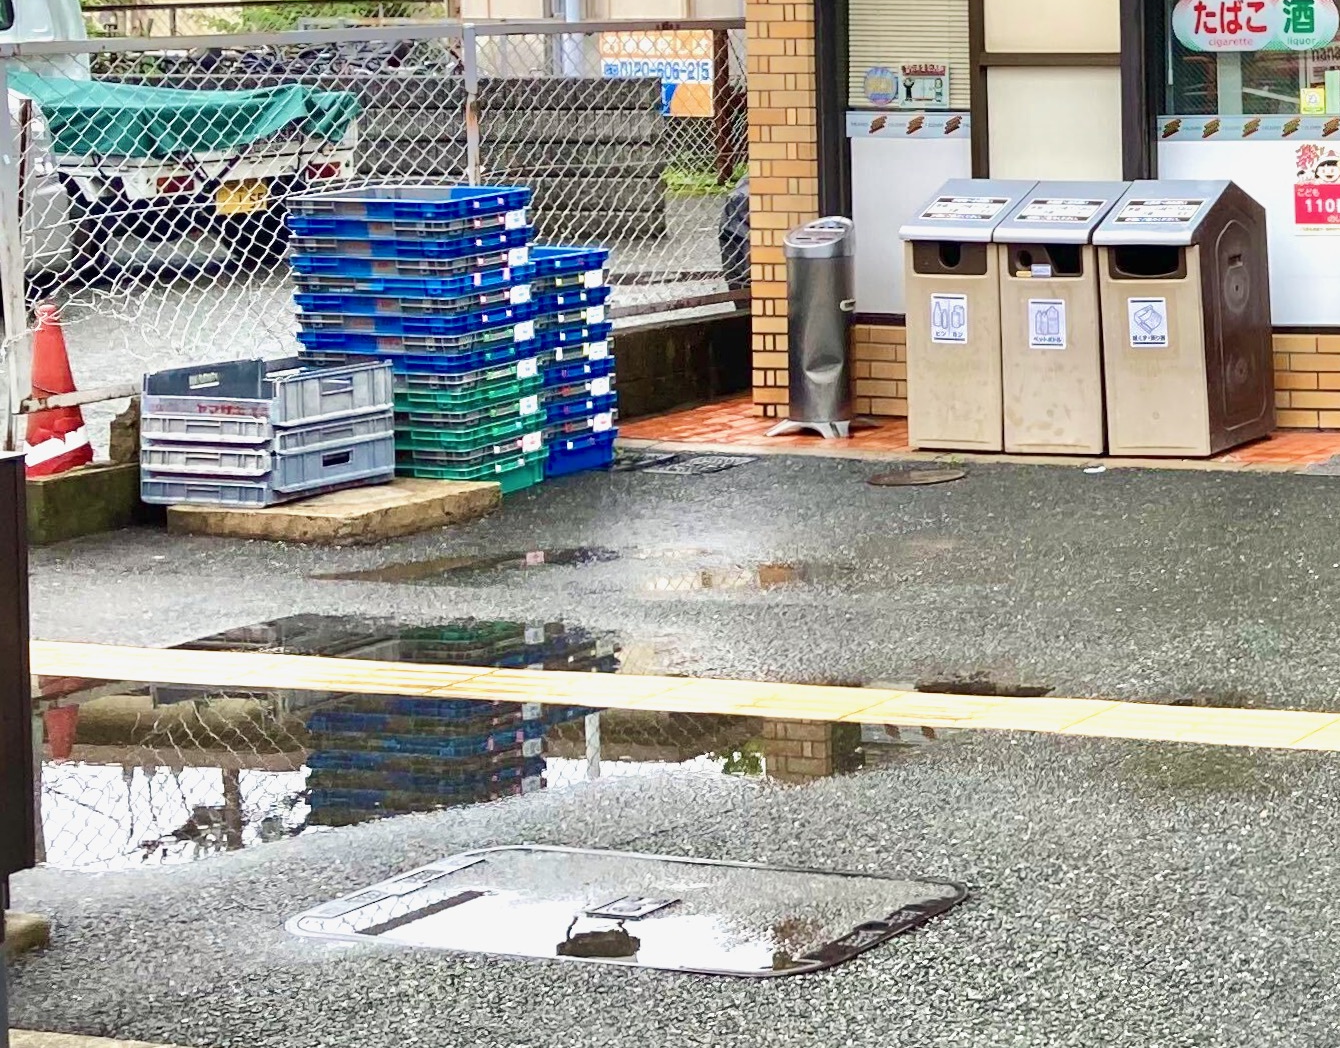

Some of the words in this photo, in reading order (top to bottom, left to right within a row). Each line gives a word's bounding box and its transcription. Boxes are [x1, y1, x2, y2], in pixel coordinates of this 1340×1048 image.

[1283, 0, 1315, 34] 酒
[1208, 37, 1254, 47] cigarette
[1287, 36, 1316, 46] liquor
